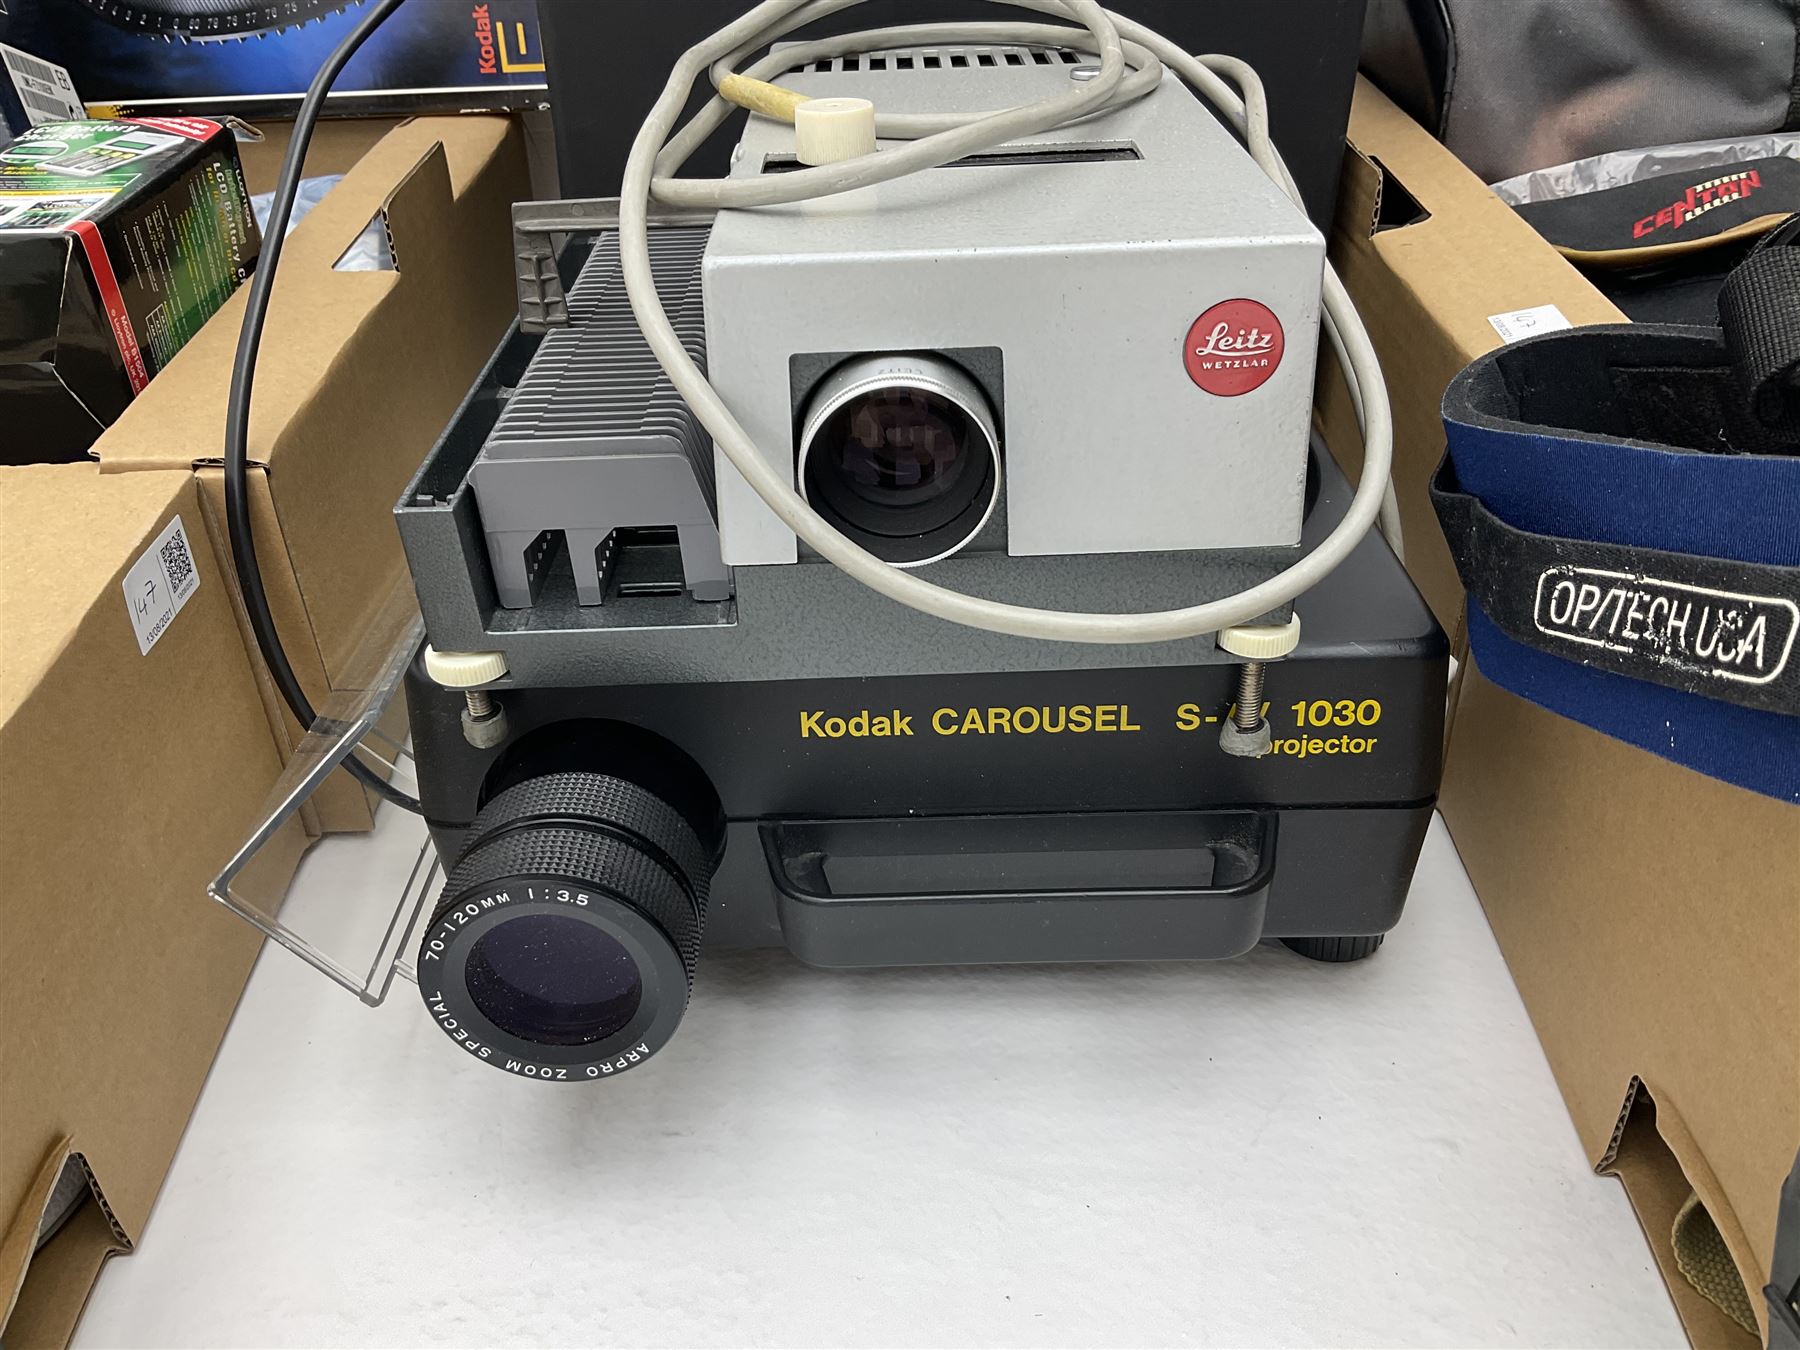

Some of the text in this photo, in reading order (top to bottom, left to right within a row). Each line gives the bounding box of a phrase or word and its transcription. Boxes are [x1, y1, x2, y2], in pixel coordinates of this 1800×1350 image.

[471, 3, 497, 74] Kodak
[212, 162, 228, 194] LCD
[224, 201, 241, 262] Battery
[235, 168, 253, 229] LLOYTRON
[120, 315, 135, 347] Model
[1195, 321, 1275, 357] Leitz
[1202, 359, 1269, 370] WETZLAR
[145, 607, 174, 645] 13/08/2021
[1549, 580, 1693, 650] OP/TECH
[799, 699, 1382, 738] Kodak CAROUSEL S- 1030
[424, 892, 511, 961] 70-120MM
[429, 989, 492, 1059] SPECIAL
[505, 1058, 567, 1080] ZOOM
[585, 1042, 650, 1077] ARPRO
